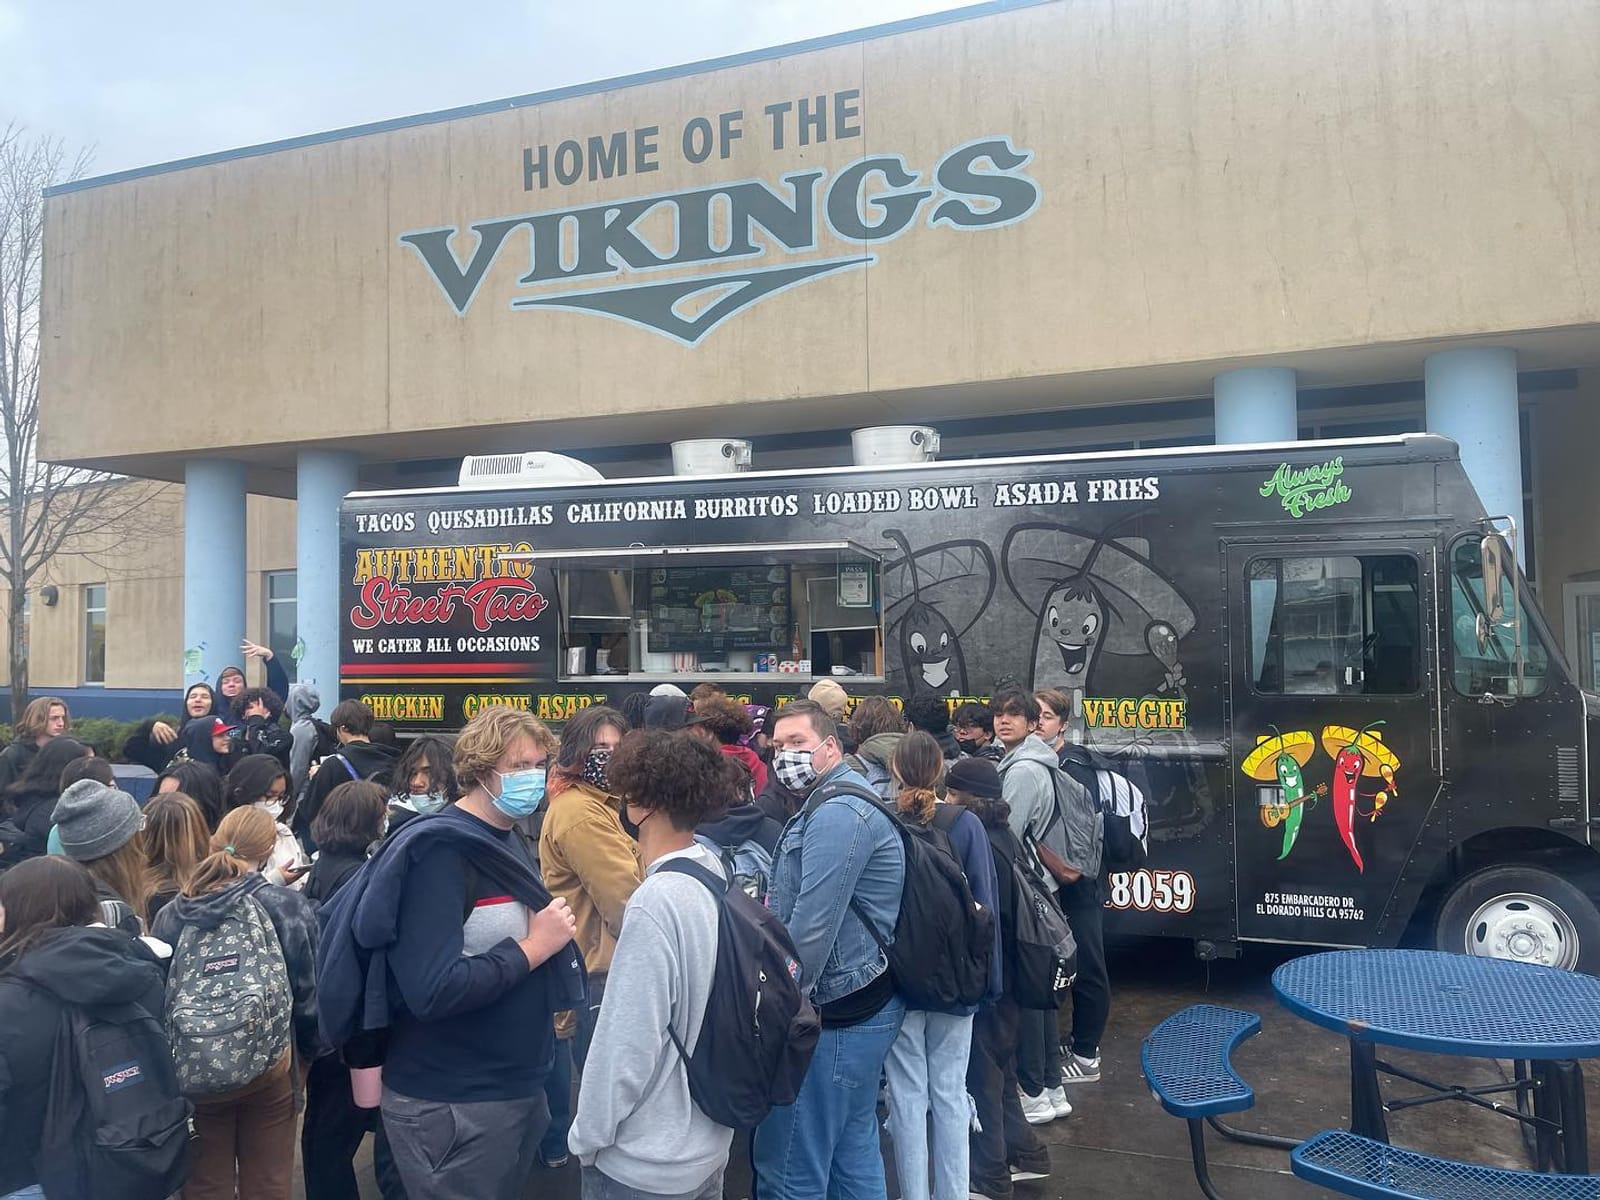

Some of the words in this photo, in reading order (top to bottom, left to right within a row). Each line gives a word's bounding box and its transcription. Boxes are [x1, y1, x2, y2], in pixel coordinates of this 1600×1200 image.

[523, 126, 660, 192] HOME
[682, 110, 744, 164] OF
[764, 88, 862, 151] THE
[397, 134, 1043, 317] VIKINGS
[1259, 456, 1343, 496] Always
[355, 512, 416, 533] TACOS
[427, 504, 554, 534] QUESADILLAS
[566, 499, 687, 524] CALIFORNIA
[694, 494, 799, 520] BURRITOS
[813, 489, 901, 515] LOADED
[908, 486, 978, 511] BOWL
[994, 480, 1079, 507] ASADA
[1087, 477, 1160, 502] FRIES
[1281, 479, 1352, 517] Fresh
[353, 542, 536, 584] AUTHENTIC
[351, 576, 465, 630] Street
[463, 576, 549, 632] Taco
[352, 639, 374, 654] WE
[377, 638, 422, 654] CATER
[426, 637, 452, 653] ALL
[456, 636, 540, 653] OCCASIONS
[1081, 698, 1186, 730] VEGGIE
[1256, 903, 1266, 914] EL
[1266, 904, 1302, 917] DORADO
[1303, 906, 1325, 918] HILLS
[1326, 908, 1338, 919] CA
[1339, 908, 1365, 921] 95762
[1264, 893, 1280, 904] 875
[1281, 893, 1341, 908] EMBARCADERO
[1342, 897, 1355, 908] DR
